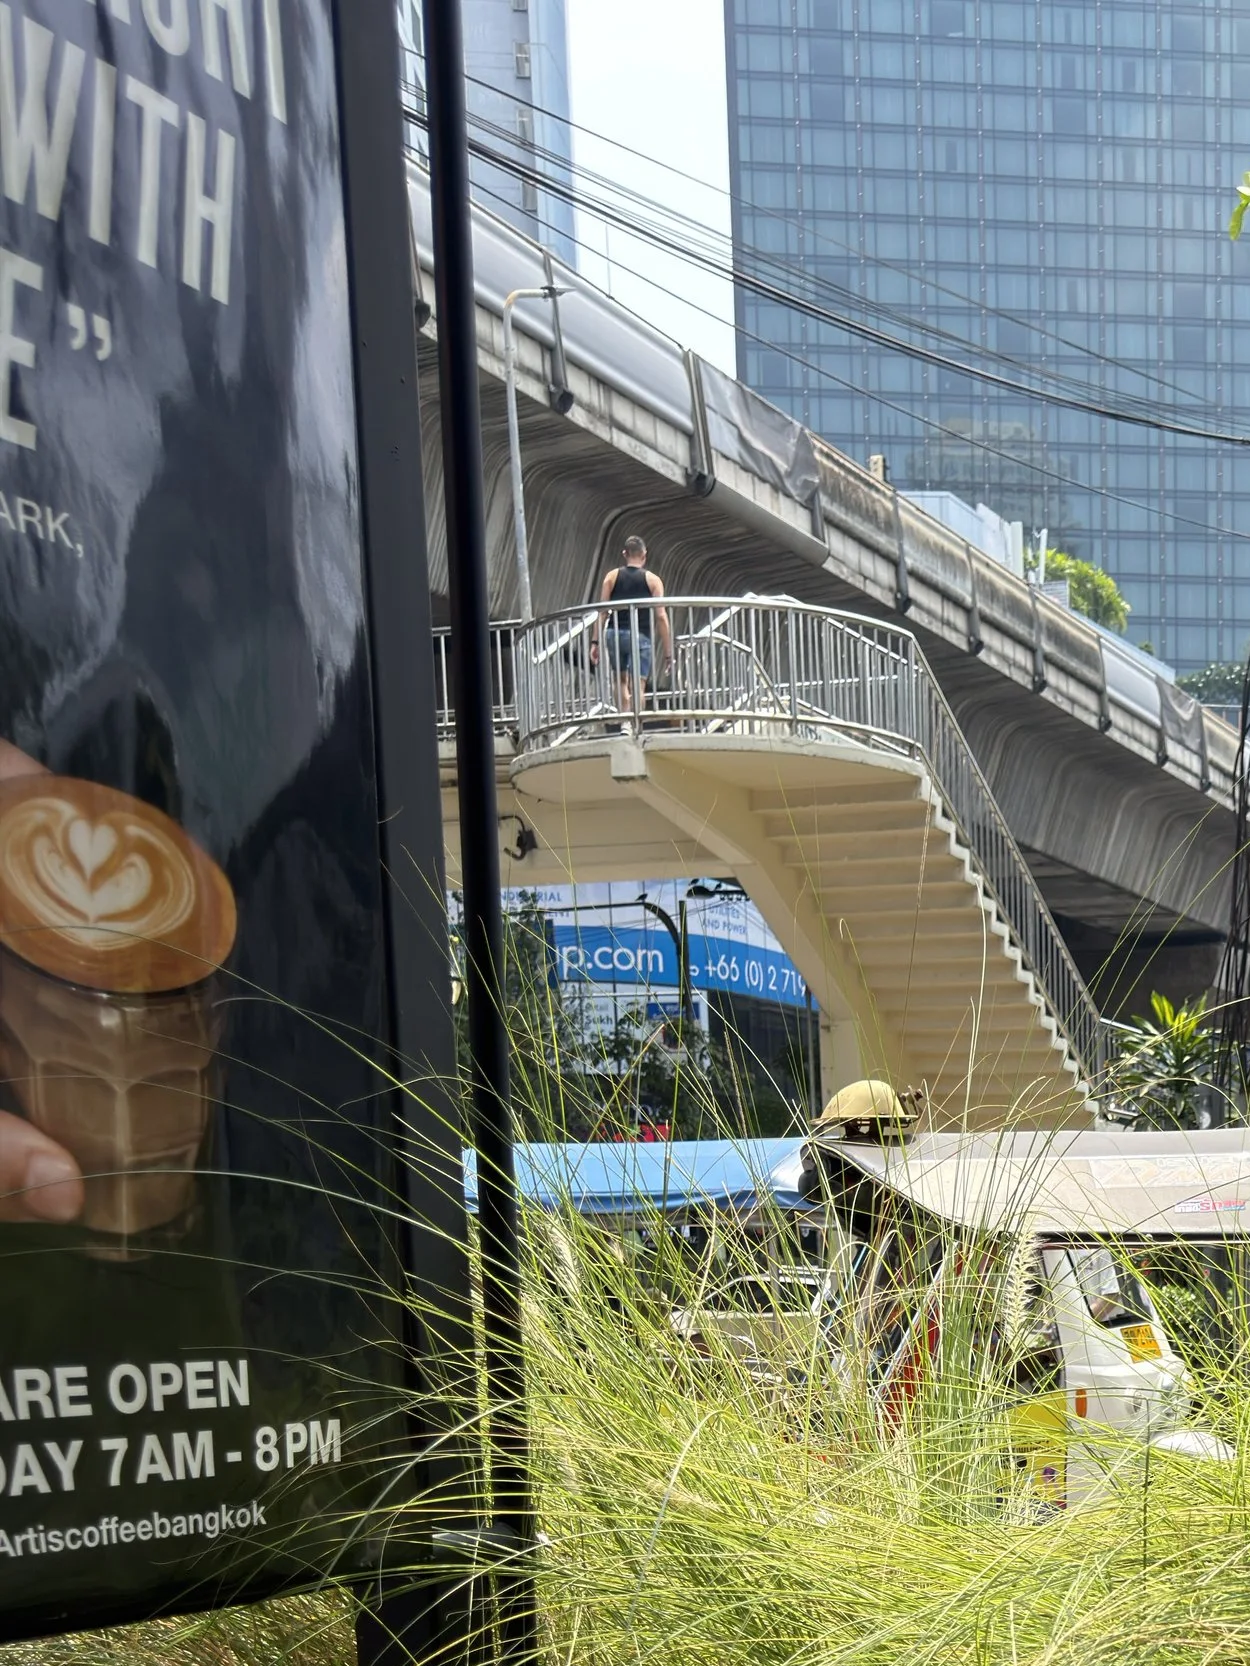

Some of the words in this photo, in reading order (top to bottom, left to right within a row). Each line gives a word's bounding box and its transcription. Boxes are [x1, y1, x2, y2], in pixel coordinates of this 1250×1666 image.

[0, 1, 236, 306] WITH
[556, 945, 664, 979] p.com
[704, 954, 740, 982] +66
[745, 960, 763, 992] (0)
[768, 965, 777, 990] 2
[108, 1359, 250, 1415] OPEN
[0, 1440, 84, 1497] AY
